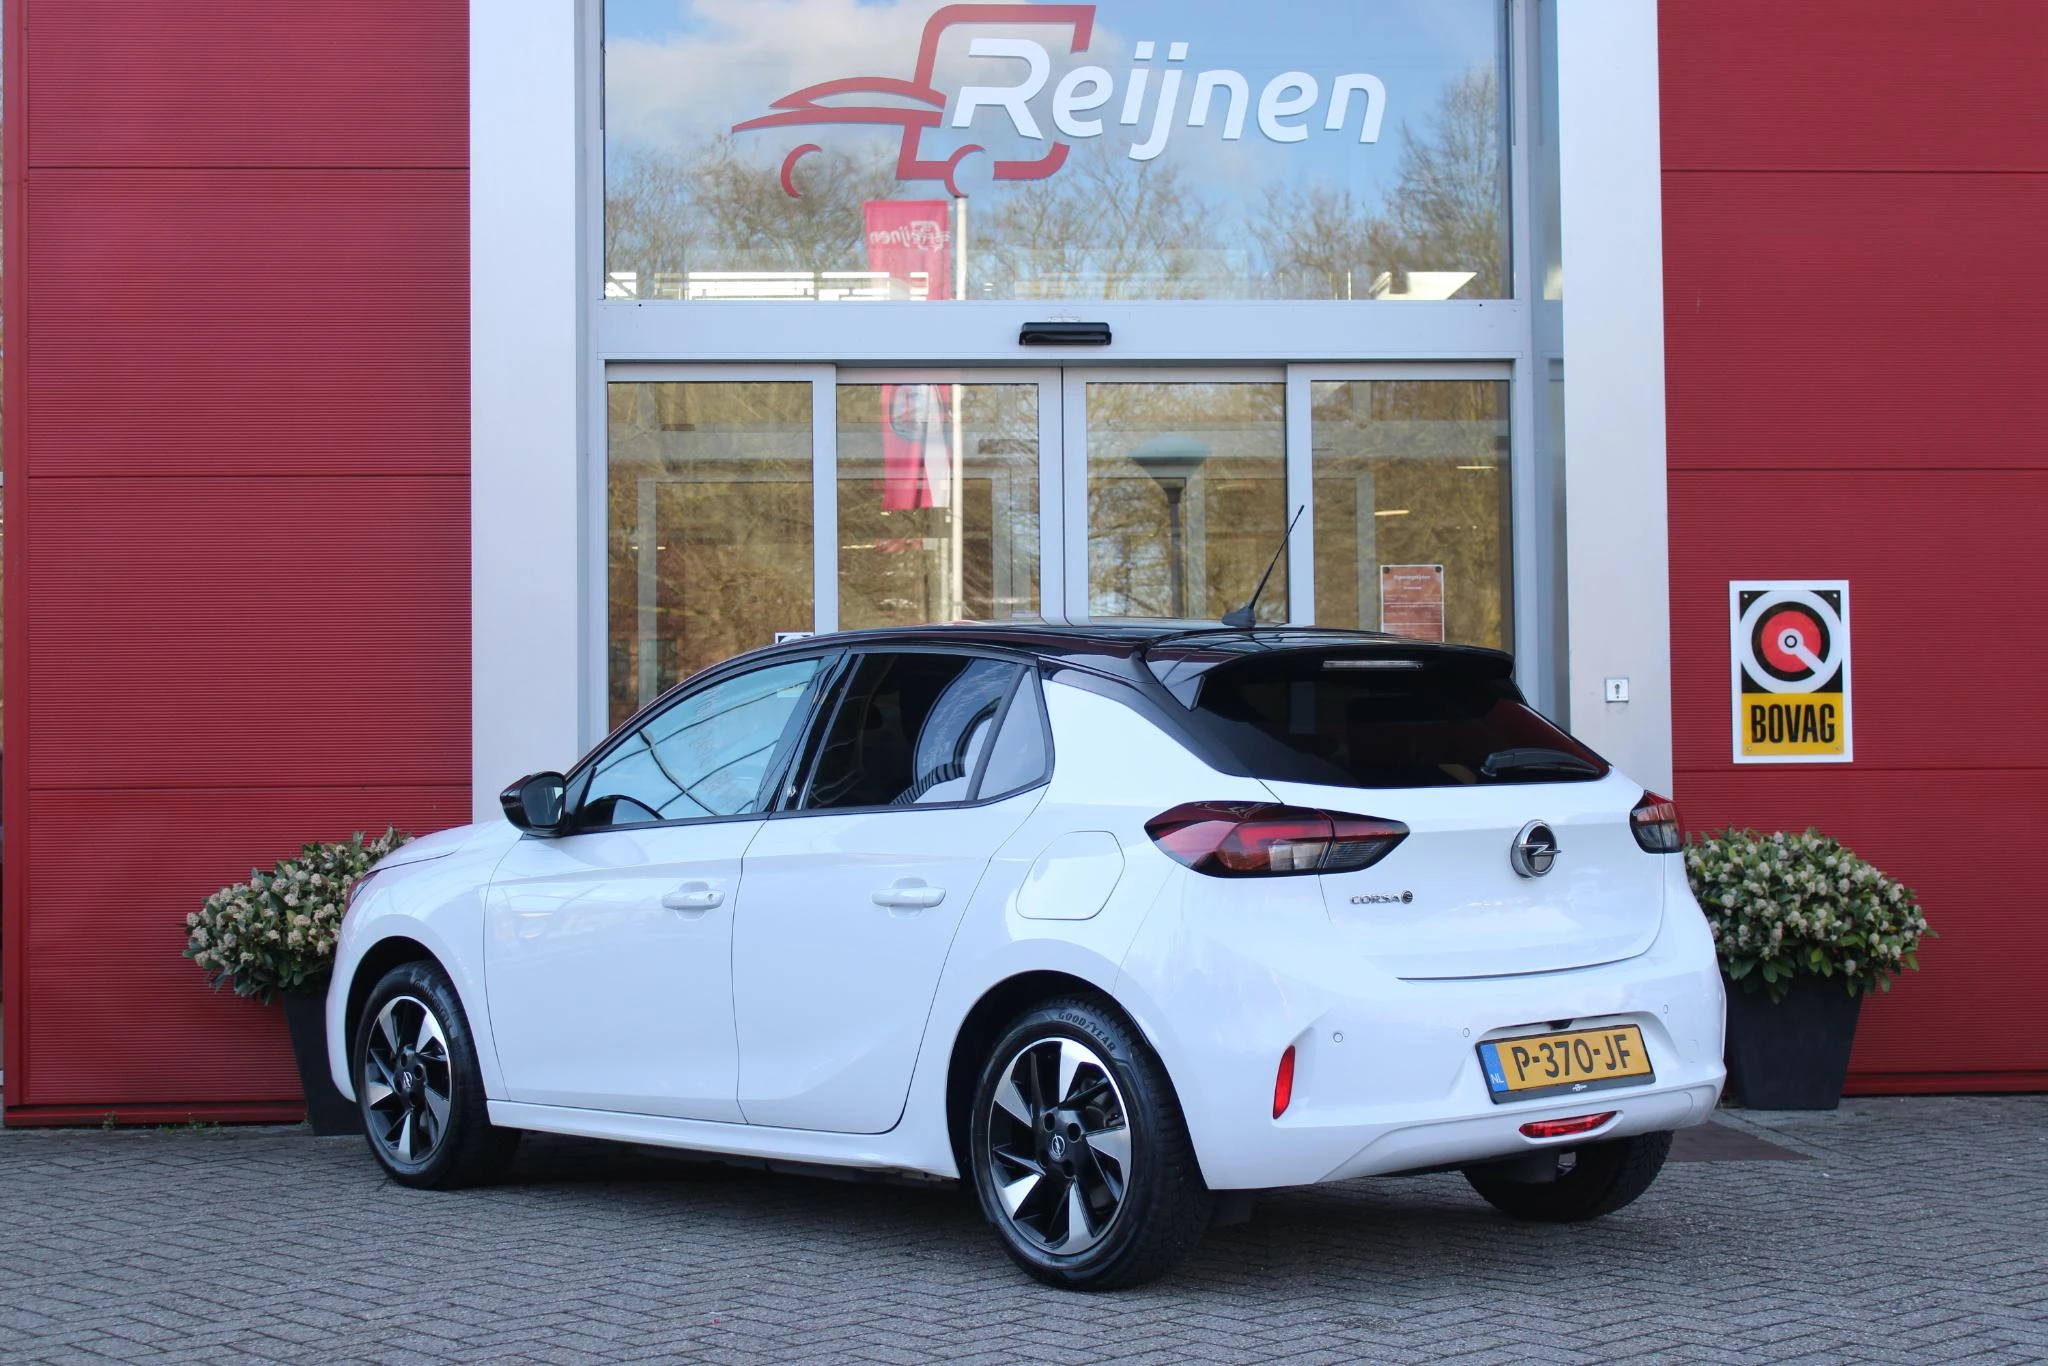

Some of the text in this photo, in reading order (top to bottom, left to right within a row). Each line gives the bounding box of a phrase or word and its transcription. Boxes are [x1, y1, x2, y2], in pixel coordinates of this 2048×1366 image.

[952, 38, 1387, 160] Reijnen
[1751, 703, 1835, 743] BOVAG
[1058, 1011, 1117, 1052] GOODYEAR
[1511, 1034, 1631, 1082] P-370-JF
[1490, 1074, 1505, 1084] NL
